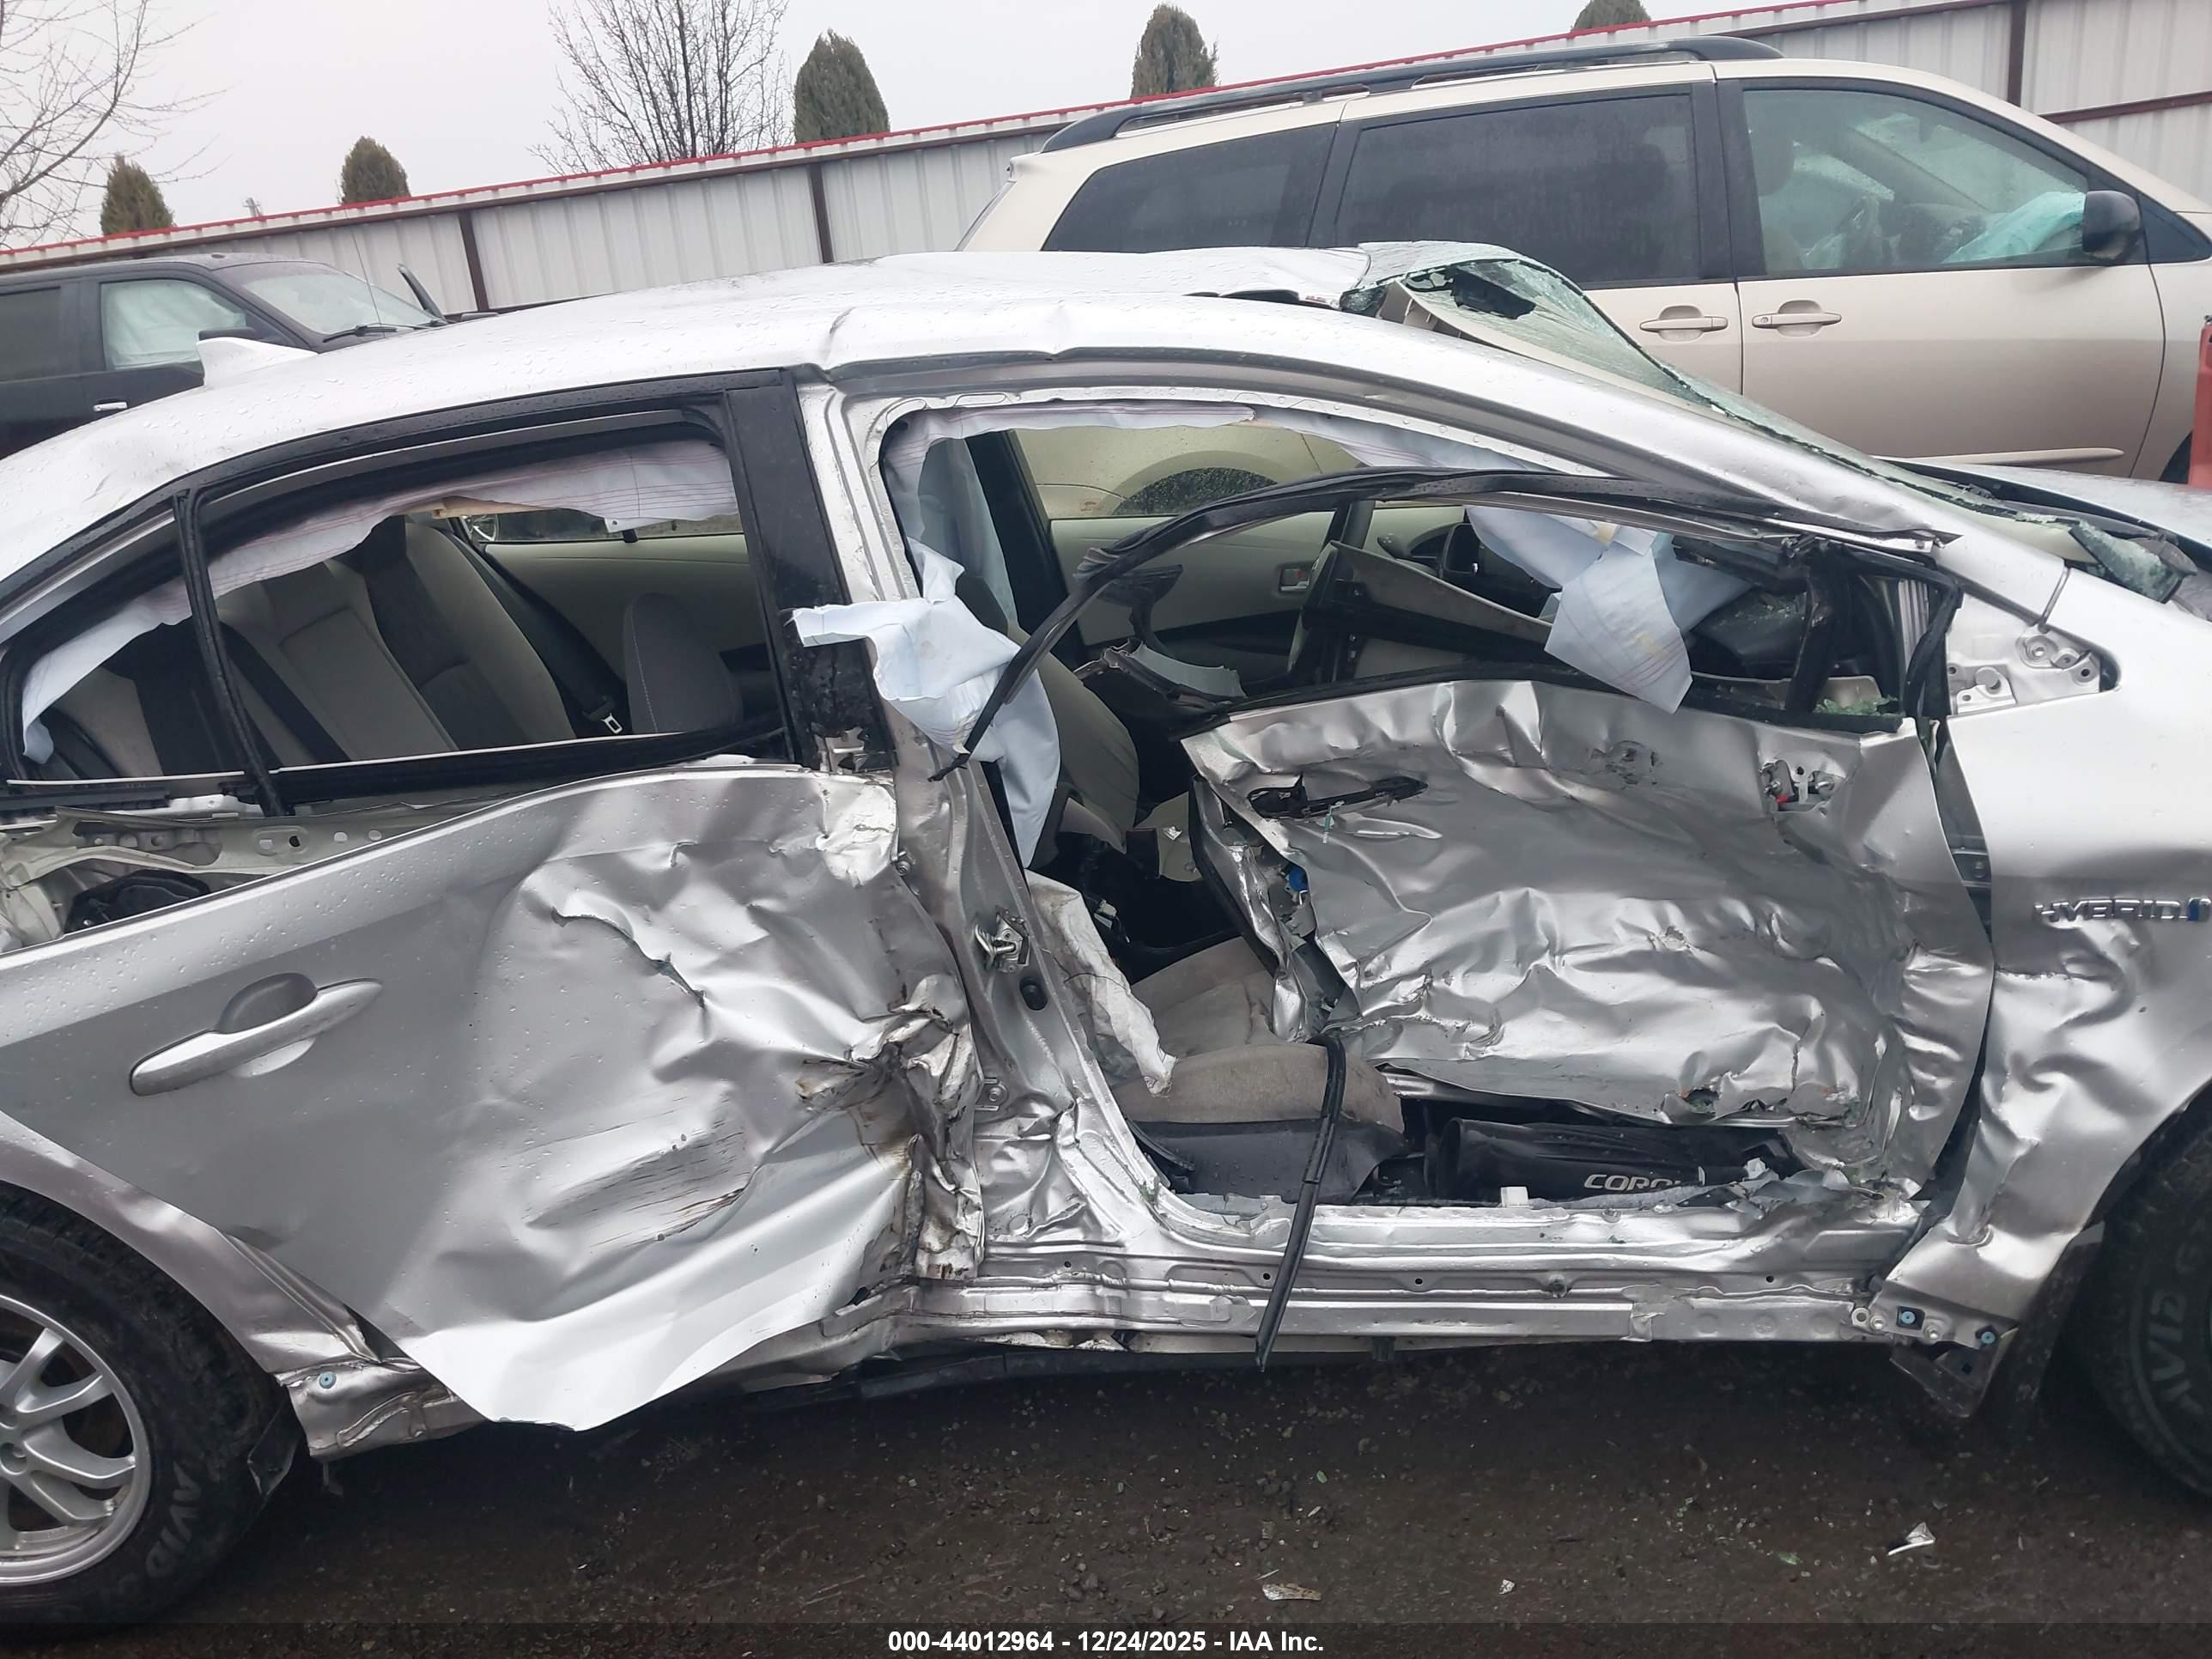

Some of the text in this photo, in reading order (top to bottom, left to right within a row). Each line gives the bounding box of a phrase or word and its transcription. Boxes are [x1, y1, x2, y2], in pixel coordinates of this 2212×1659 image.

[2033, 897, 2183, 922] HYBRID
[2148, 1289, 2205, 1416] AVID
[145, 1461, 202, 1578] AVID
